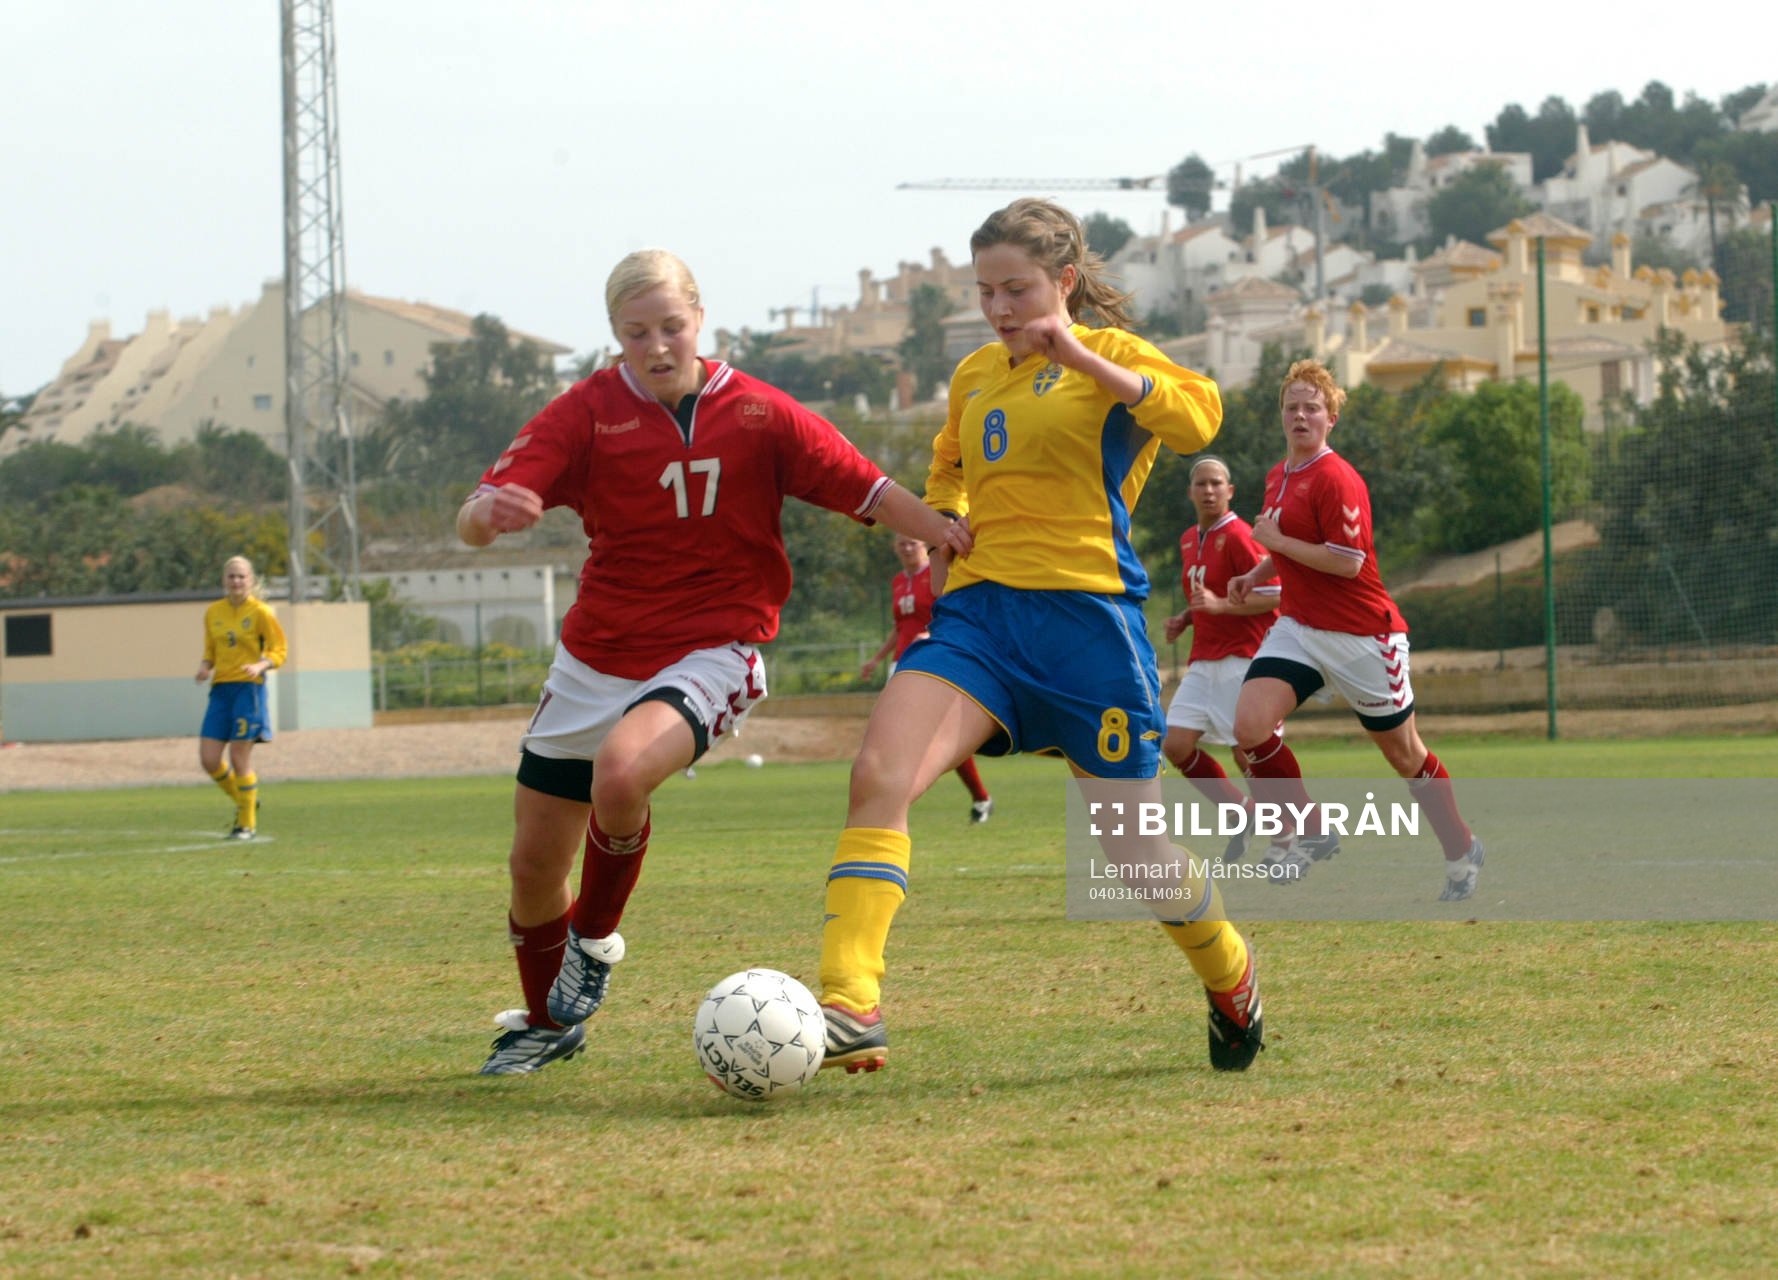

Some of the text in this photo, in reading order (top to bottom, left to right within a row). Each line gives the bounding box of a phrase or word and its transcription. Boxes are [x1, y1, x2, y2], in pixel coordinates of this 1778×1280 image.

[983, 408, 1008, 462] 8
[658, 457, 721, 519] 17
[236, 718, 248, 737] 3
[1097, 706, 1130, 763] 8
[703, 1041, 766, 1097] SELECT
